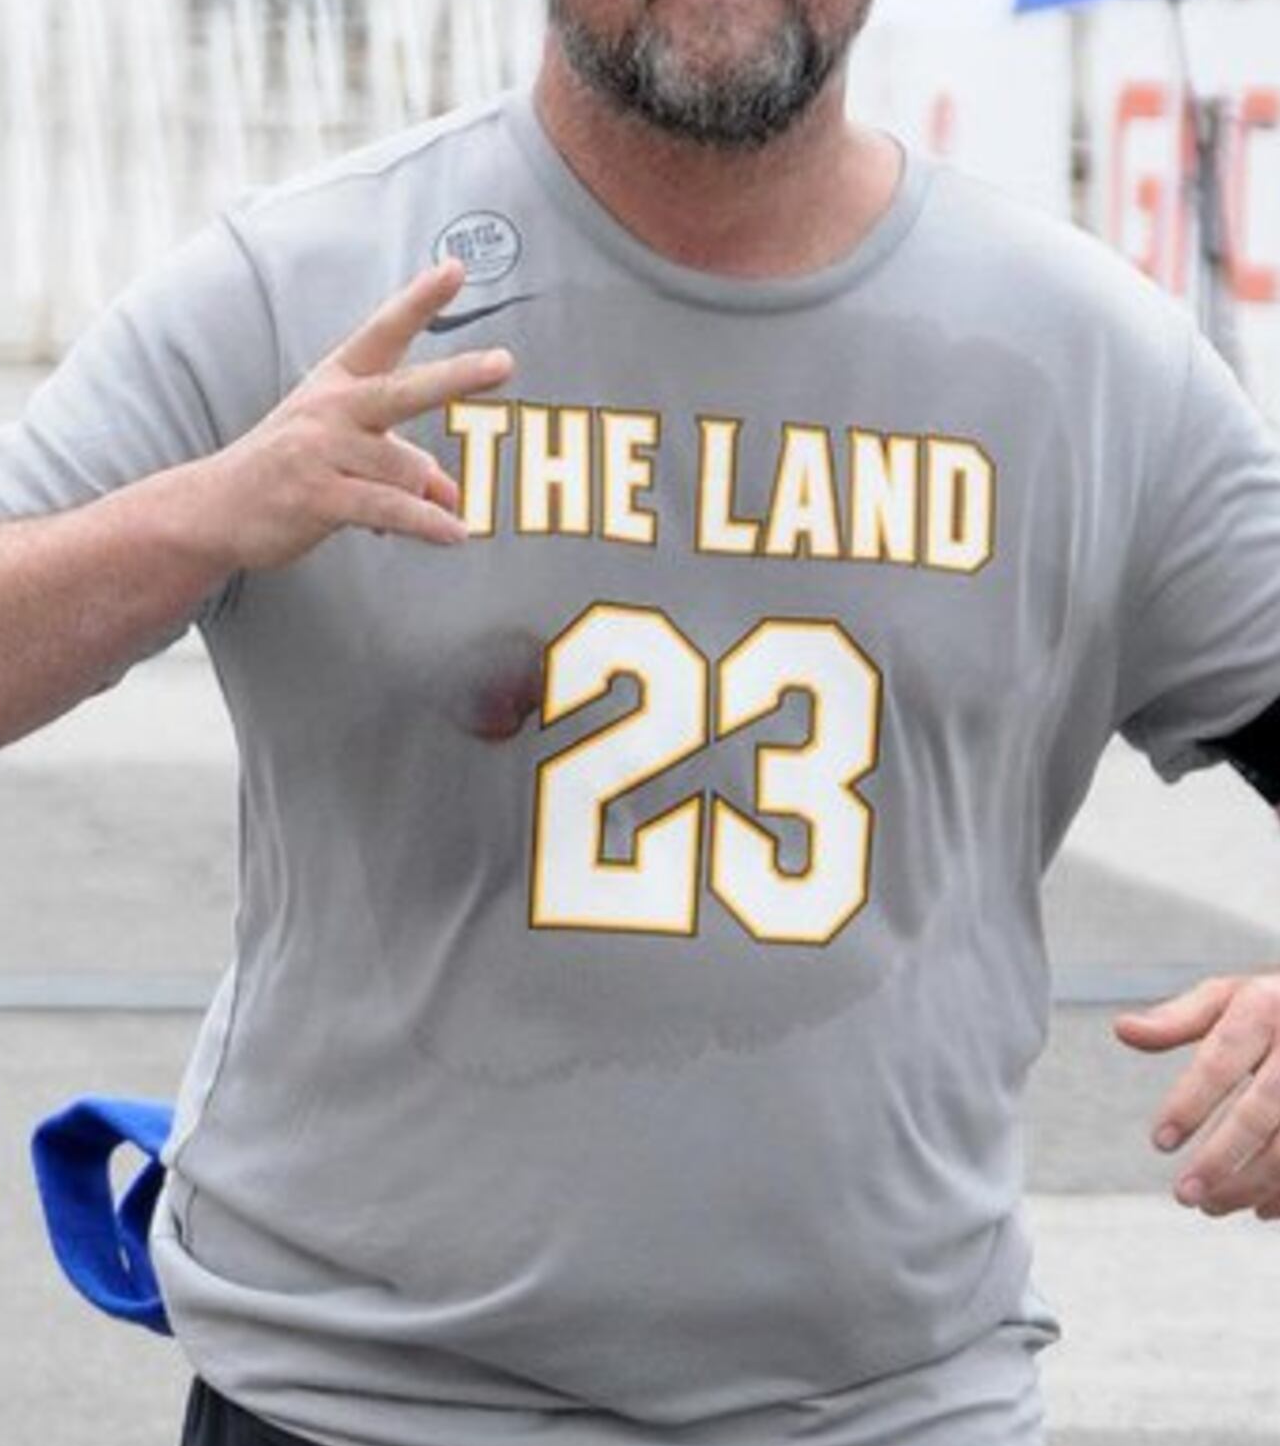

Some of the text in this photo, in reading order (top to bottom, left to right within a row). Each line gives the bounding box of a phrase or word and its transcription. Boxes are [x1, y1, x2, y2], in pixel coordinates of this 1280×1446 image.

[446, 399, 997, 576] THE LAND
[529, 600, 885, 947] 23
